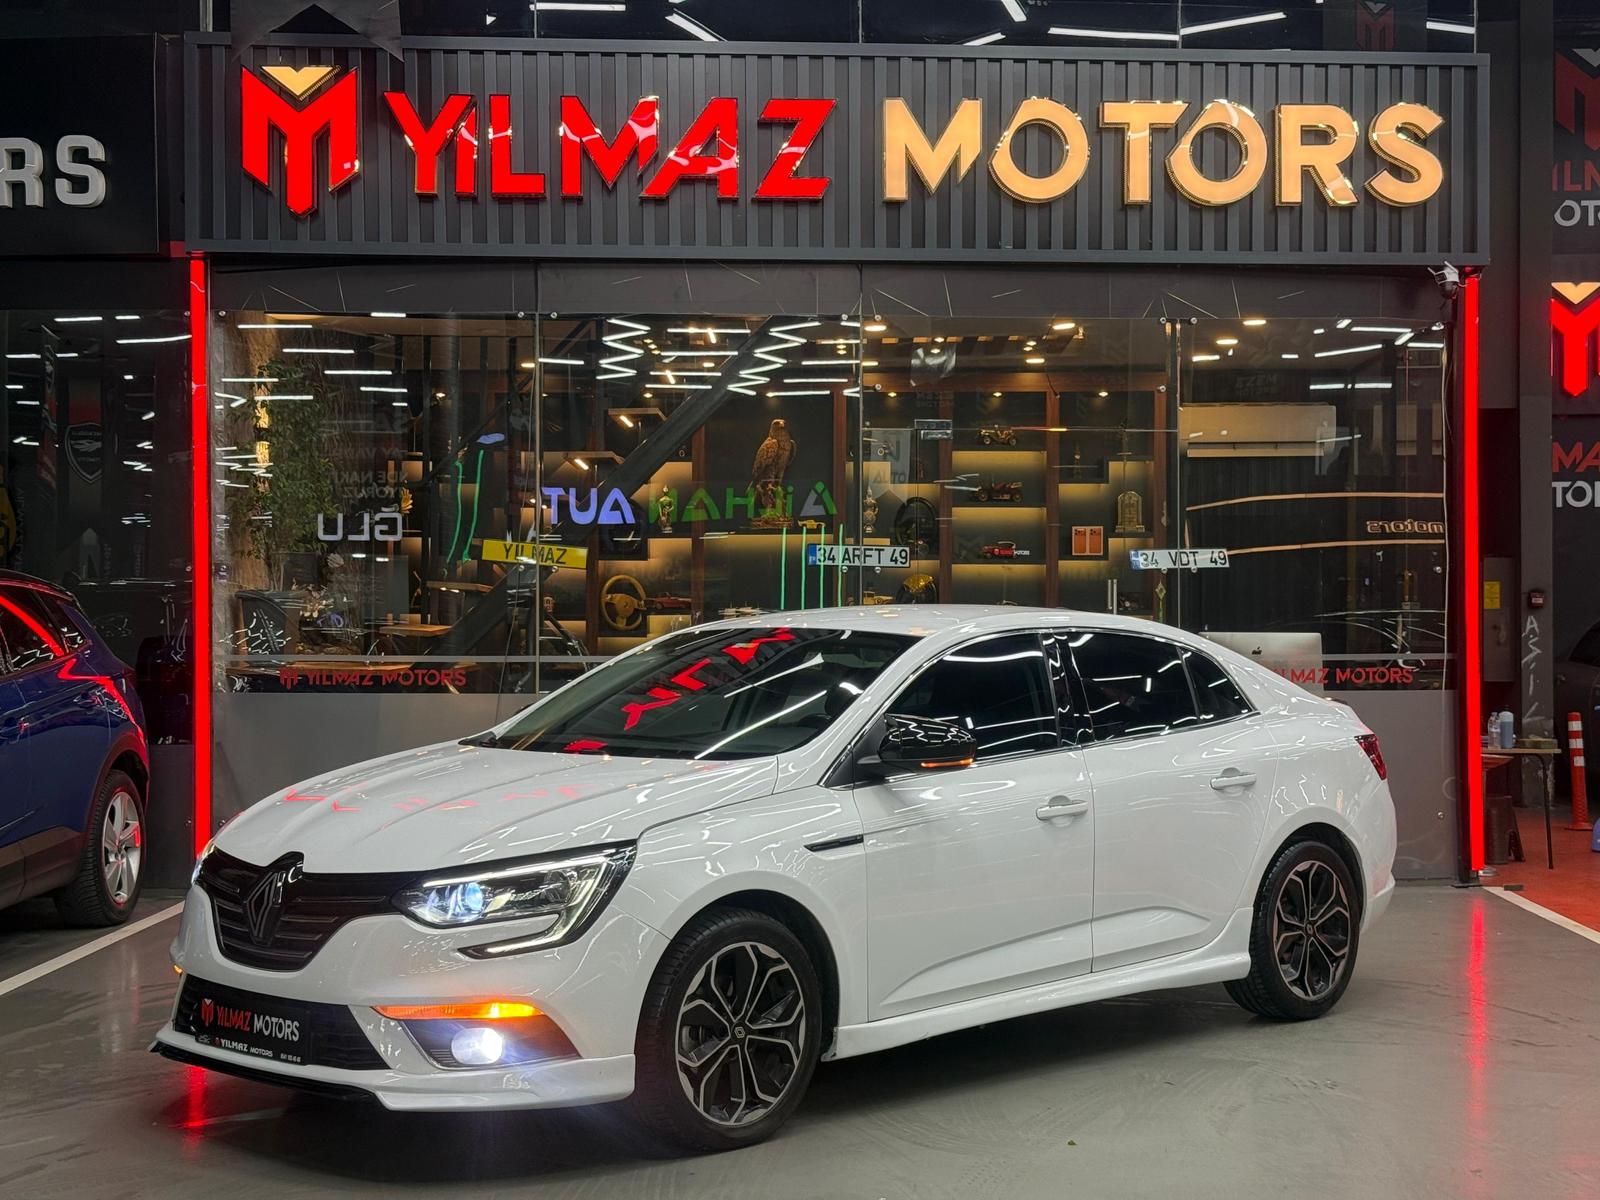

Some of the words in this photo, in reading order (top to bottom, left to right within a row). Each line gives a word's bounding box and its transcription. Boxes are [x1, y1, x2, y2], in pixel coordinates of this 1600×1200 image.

[384, 92, 836, 201] YILMAZ
[882, 97, 1445, 207] MOTORS
[1551, 480, 1600, 508] TO
[503, 543, 567, 565] YILMAZ
[817, 547, 836, 563] 34
[889, 548, 908, 565] 49
[1139, 551, 1158, 567] 34
[1168, 551, 1198, 566] VDT
[1209, 550, 1227, 566] 49
[306, 670, 373, 686] YILMAZ
[382, 670, 466, 687] MOTORS
[1336, 667, 1413, 684] MOTORS
[217, 1005, 252, 1032] YILMAZ
[254, 1014, 300, 1042] MOTORS
